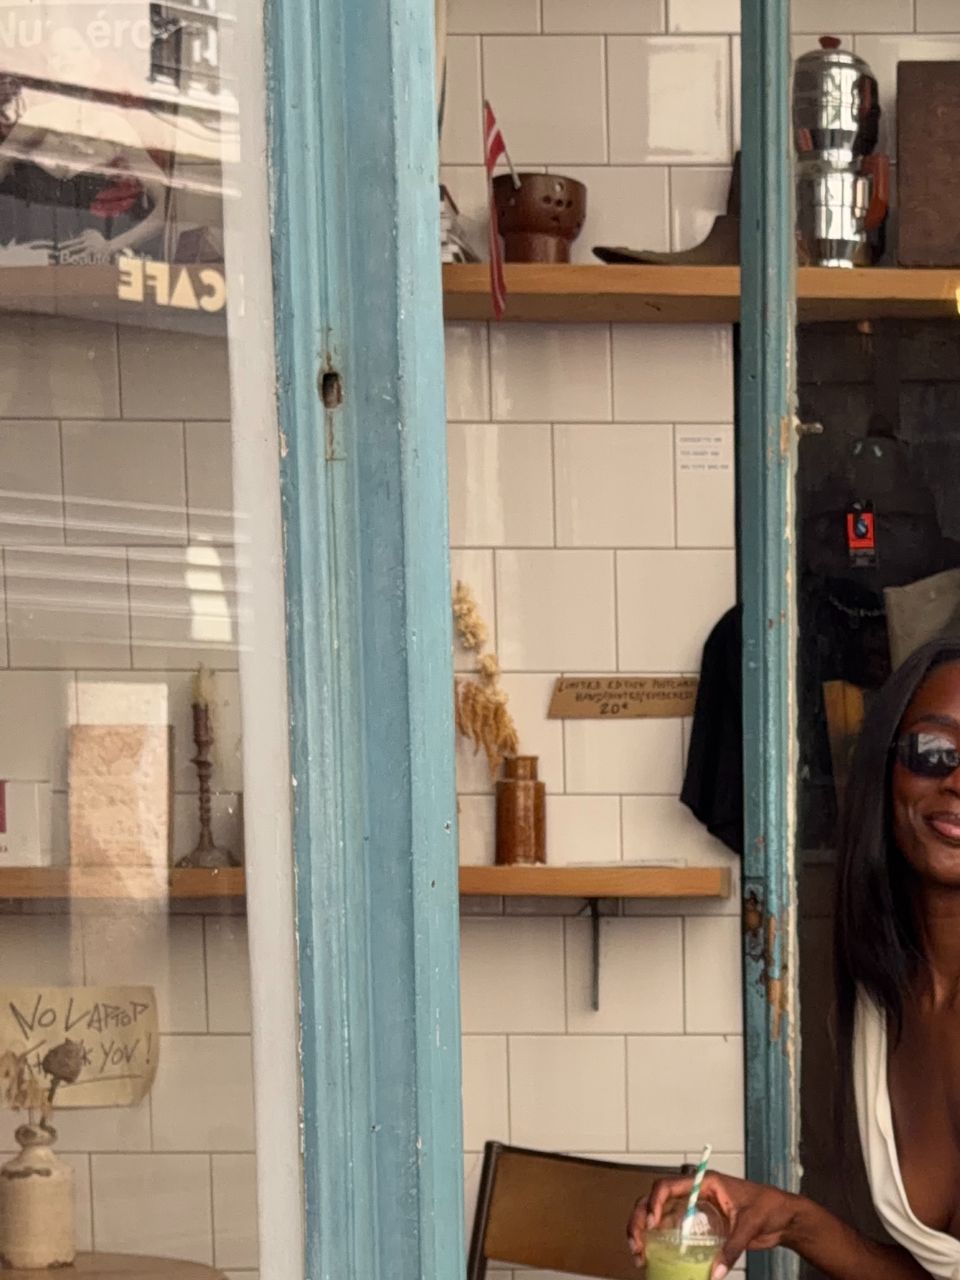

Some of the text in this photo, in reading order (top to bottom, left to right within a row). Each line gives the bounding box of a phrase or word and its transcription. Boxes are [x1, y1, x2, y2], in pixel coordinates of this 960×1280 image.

[0, 10, 149, 49] Nuéro
[8, 994, 150, 1041] NO LAPTOP
